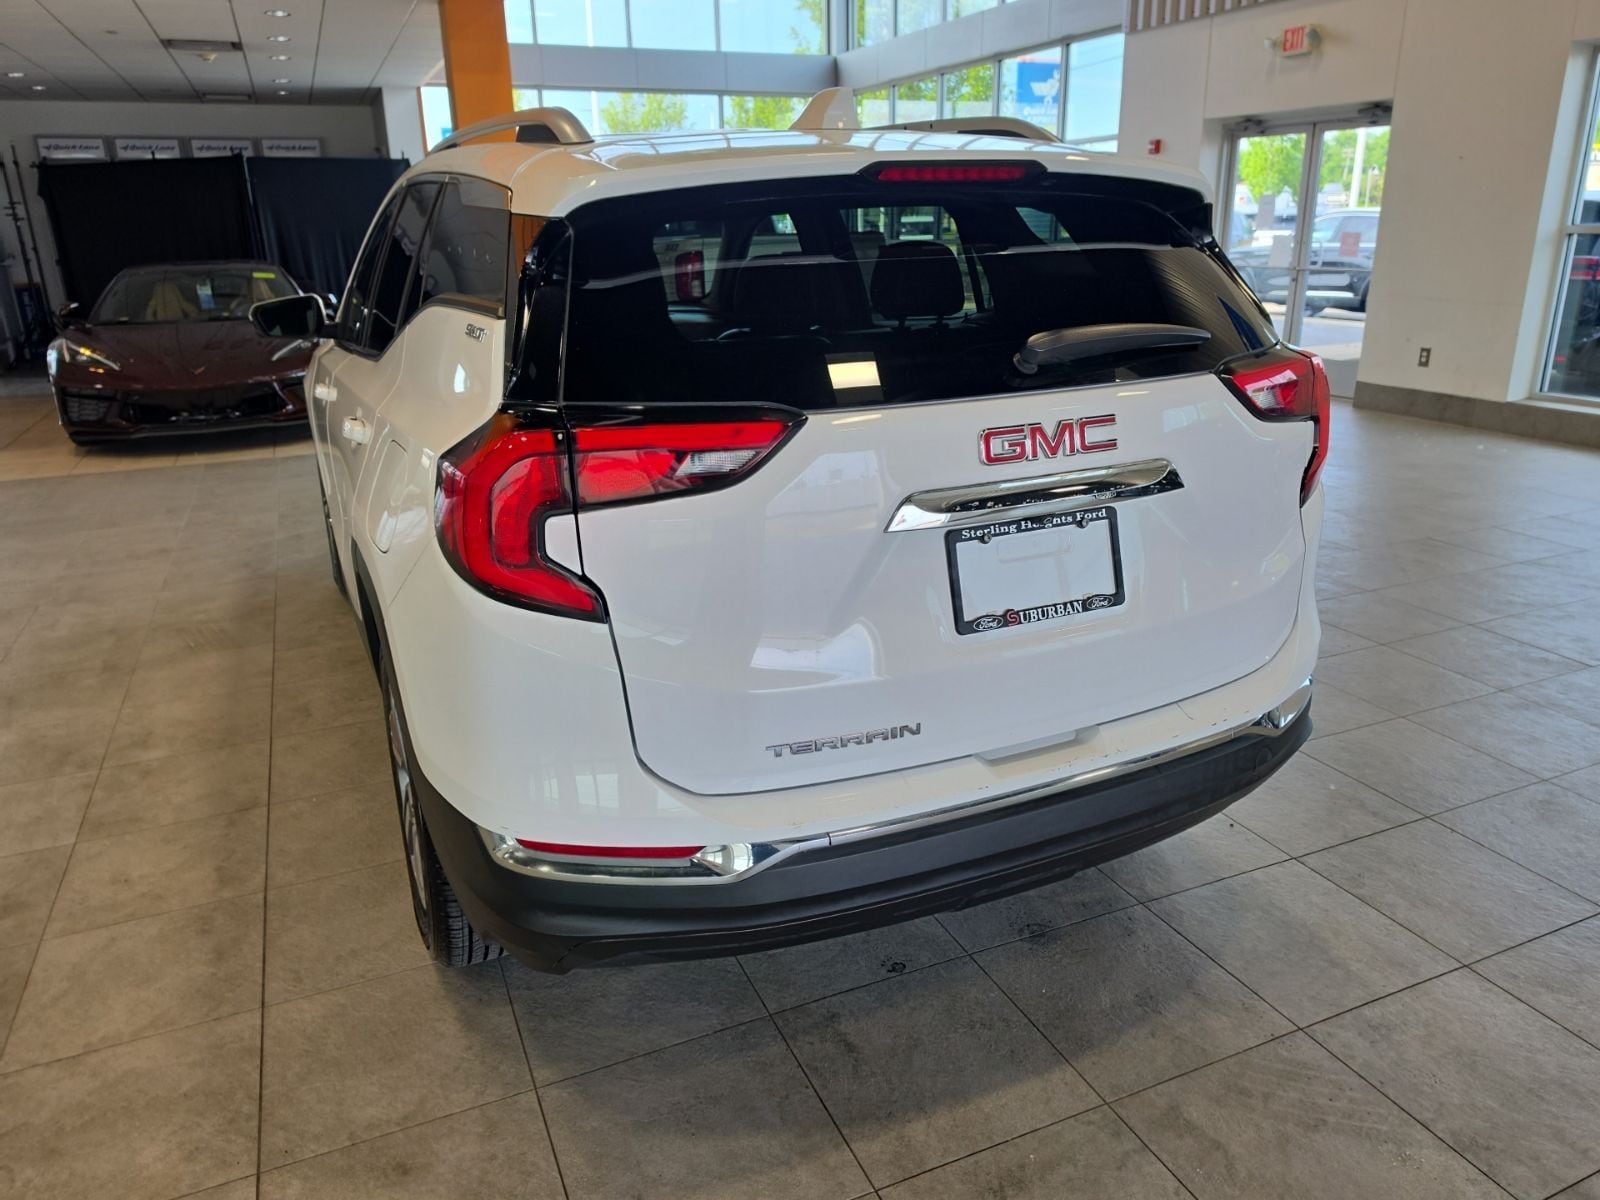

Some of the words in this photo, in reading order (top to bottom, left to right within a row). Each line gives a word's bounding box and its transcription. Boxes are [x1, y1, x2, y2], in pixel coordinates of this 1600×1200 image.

[1283, 26, 1306, 51] EXIT
[978, 414, 1118, 465] GMC
[962, 523, 1017, 539] Sterling
[1020, 515, 1073, 529] Heghts
[1076, 509, 1106, 521] Ford
[1006, 601, 1083, 626] SUBURBAN
[765, 722, 921, 758] TERRAIN
